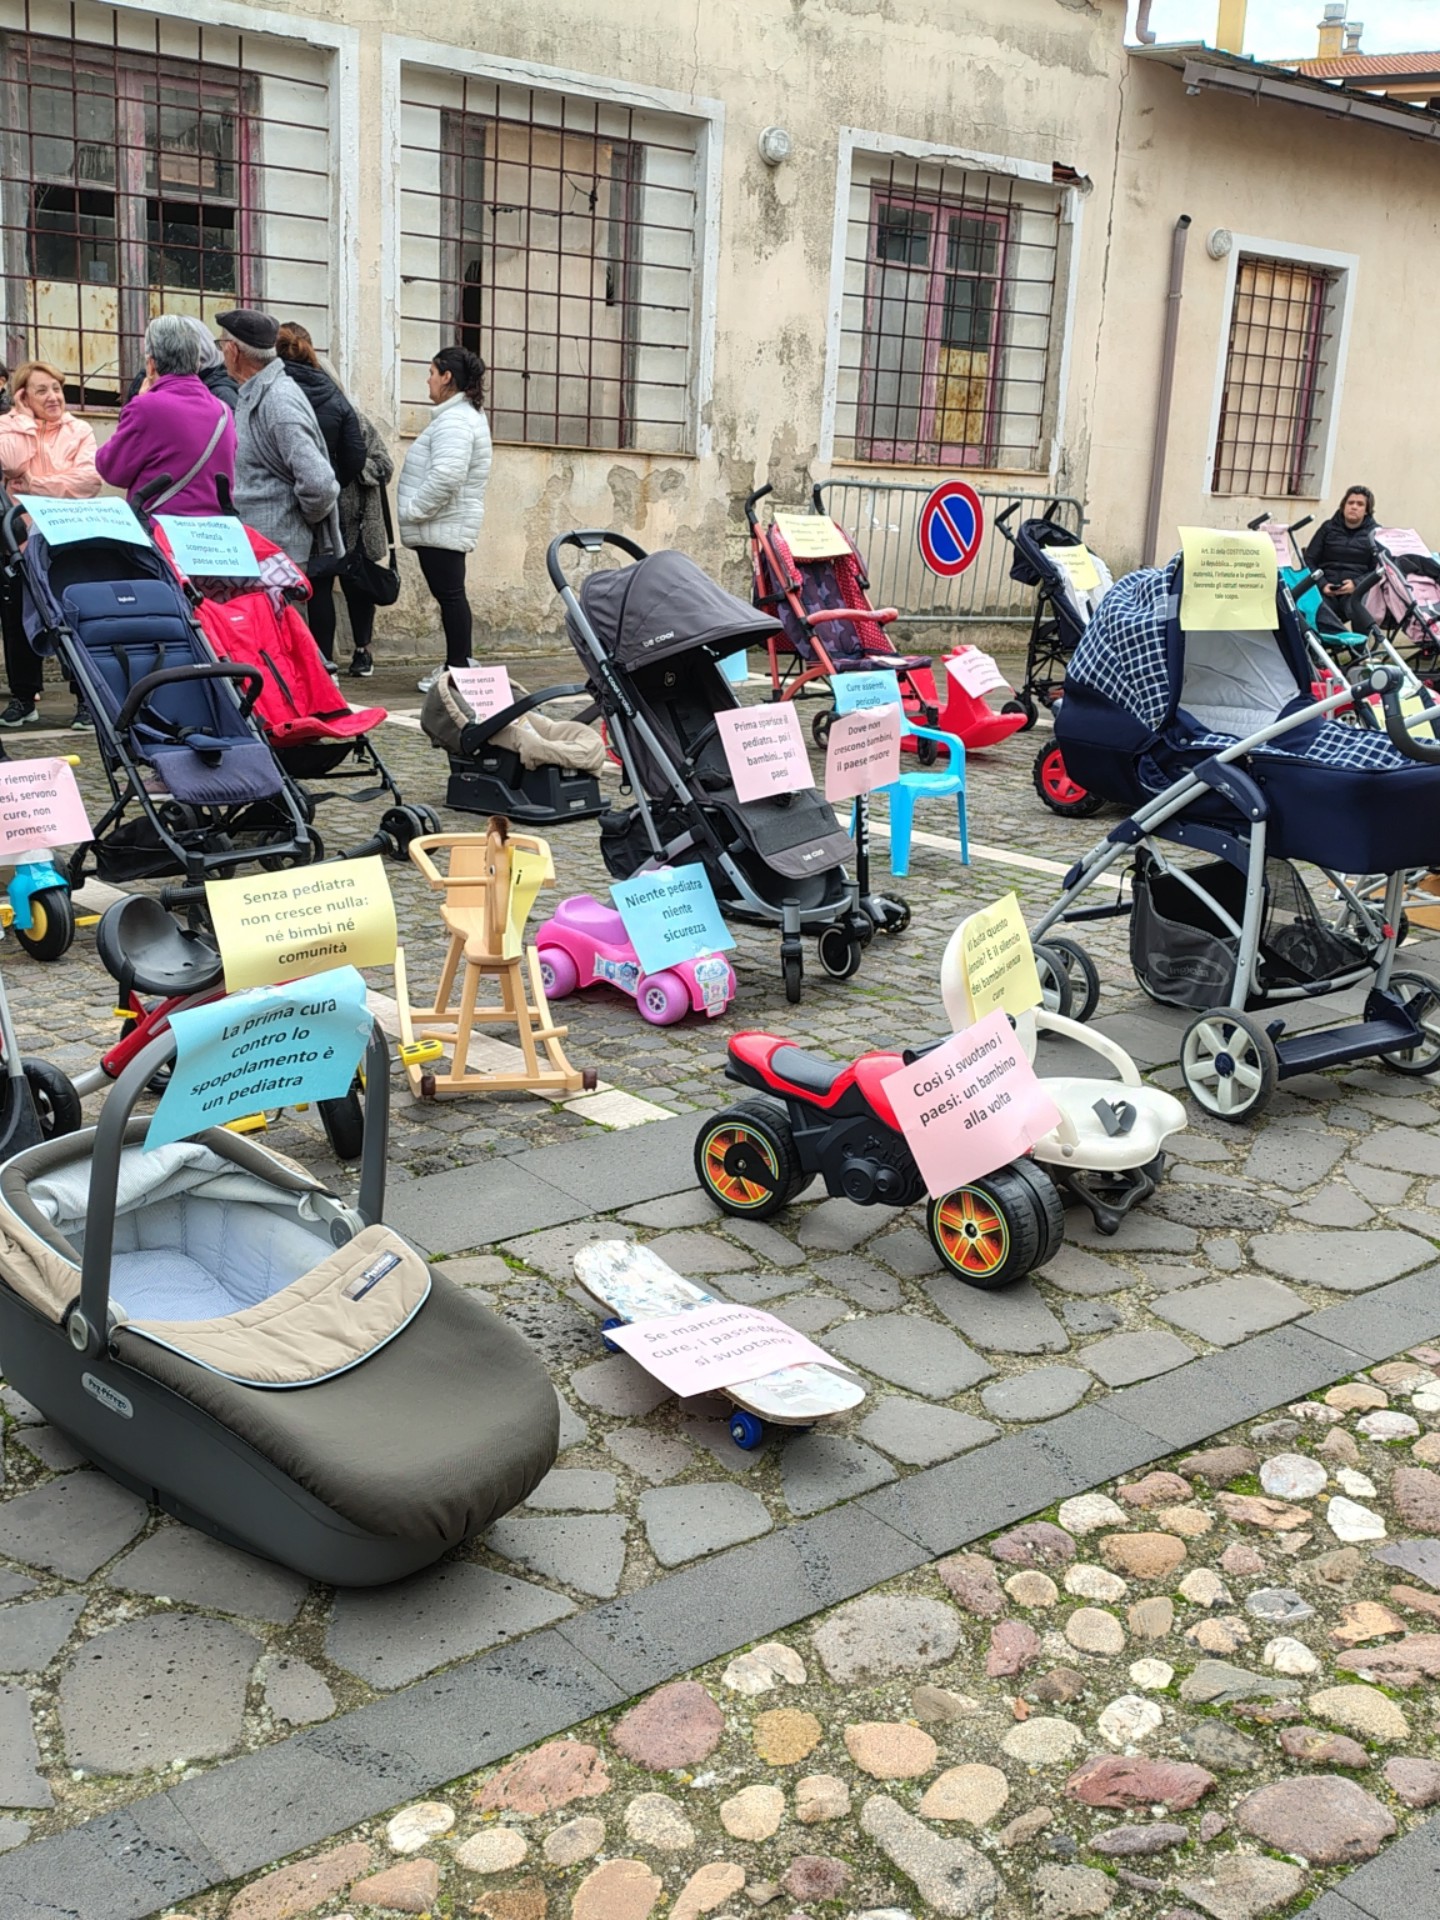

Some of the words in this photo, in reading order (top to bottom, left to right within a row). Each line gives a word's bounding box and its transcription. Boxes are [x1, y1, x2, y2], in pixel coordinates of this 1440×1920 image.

[192, 558, 213, 566] paese
[654, 630, 675, 643] cool
[846, 683, 861, 693] Cure
[855, 696, 881, 708] pericolo
[734, 722, 757, 732] Prima
[758, 716, 783, 729] sparisce
[848, 724, 867, 736] Dove
[868, 721, 881, 731] non
[834, 742, 866, 756] crescono
[836, 761, 842, 772] il
[843, 756, 868, 772] paese
[868, 749, 891, 763] muore
[4, 771, 47, 785] riempire
[48, 770, 52, 780] i
[771, 768, 789, 781] paesi
[0, 792, 18, 804] esi,
[20, 789, 57, 801] servono
[3, 809, 31, 821] cure,
[33, 807, 51, 817] non
[5, 823, 57, 840] promesse
[243, 889, 288, 906] Senza
[291, 877, 356, 900] pediatra
[624, 887, 667, 909] Niente
[666, 879, 704, 898] pediatra
[240, 914, 271, 927] non
[275, 904, 323, 922] cresce
[326, 896, 369, 913] nulla:
[662, 903, 694, 920] niente
[265, 929, 285, 944] né
[288, 921, 333, 941] bimbi
[336, 917, 356, 932] né
[663, 923, 708, 943] sicurezza
[986, 918, 1009, 940] questo
[278, 941, 348, 965] comunità
[986, 947, 994, 961] È
[999, 932, 1021, 953] silenzio
[971, 981, 982, 996] dei
[981, 963, 1006, 990] bambini
[992, 986, 1006, 1002] cure
[221, 1024, 240, 1041] La
[243, 1006, 295, 1034] prima
[299, 998, 337, 1017] cura
[231, 1028, 287, 1059] contro
[291, 1026, 310, 1041] lo
[189, 1049, 319, 1096] spopolamento
[322, 1045, 335, 1060] è
[912, 1071, 944, 1098] Così
[944, 1064, 956, 1081] si
[956, 1039, 998, 1074] svuotano
[997, 1031, 1003, 1045] i
[201, 1095, 224, 1112] un
[227, 1074, 304, 1104] pediatra
[919, 1093, 962, 1127] paesi:
[963, 1084, 980, 1100] un
[980, 1055, 1017, 1090] bambino
[963, 1107, 989, 1130] alla
[987, 1090, 1012, 1113] volta
[643, 1332, 668, 1343] Se
[670, 1313, 749, 1337] mancano
[651, 1343, 699, 1359] cure,
[697, 1338, 709, 1347] i
[694, 1355, 711, 1367] si
